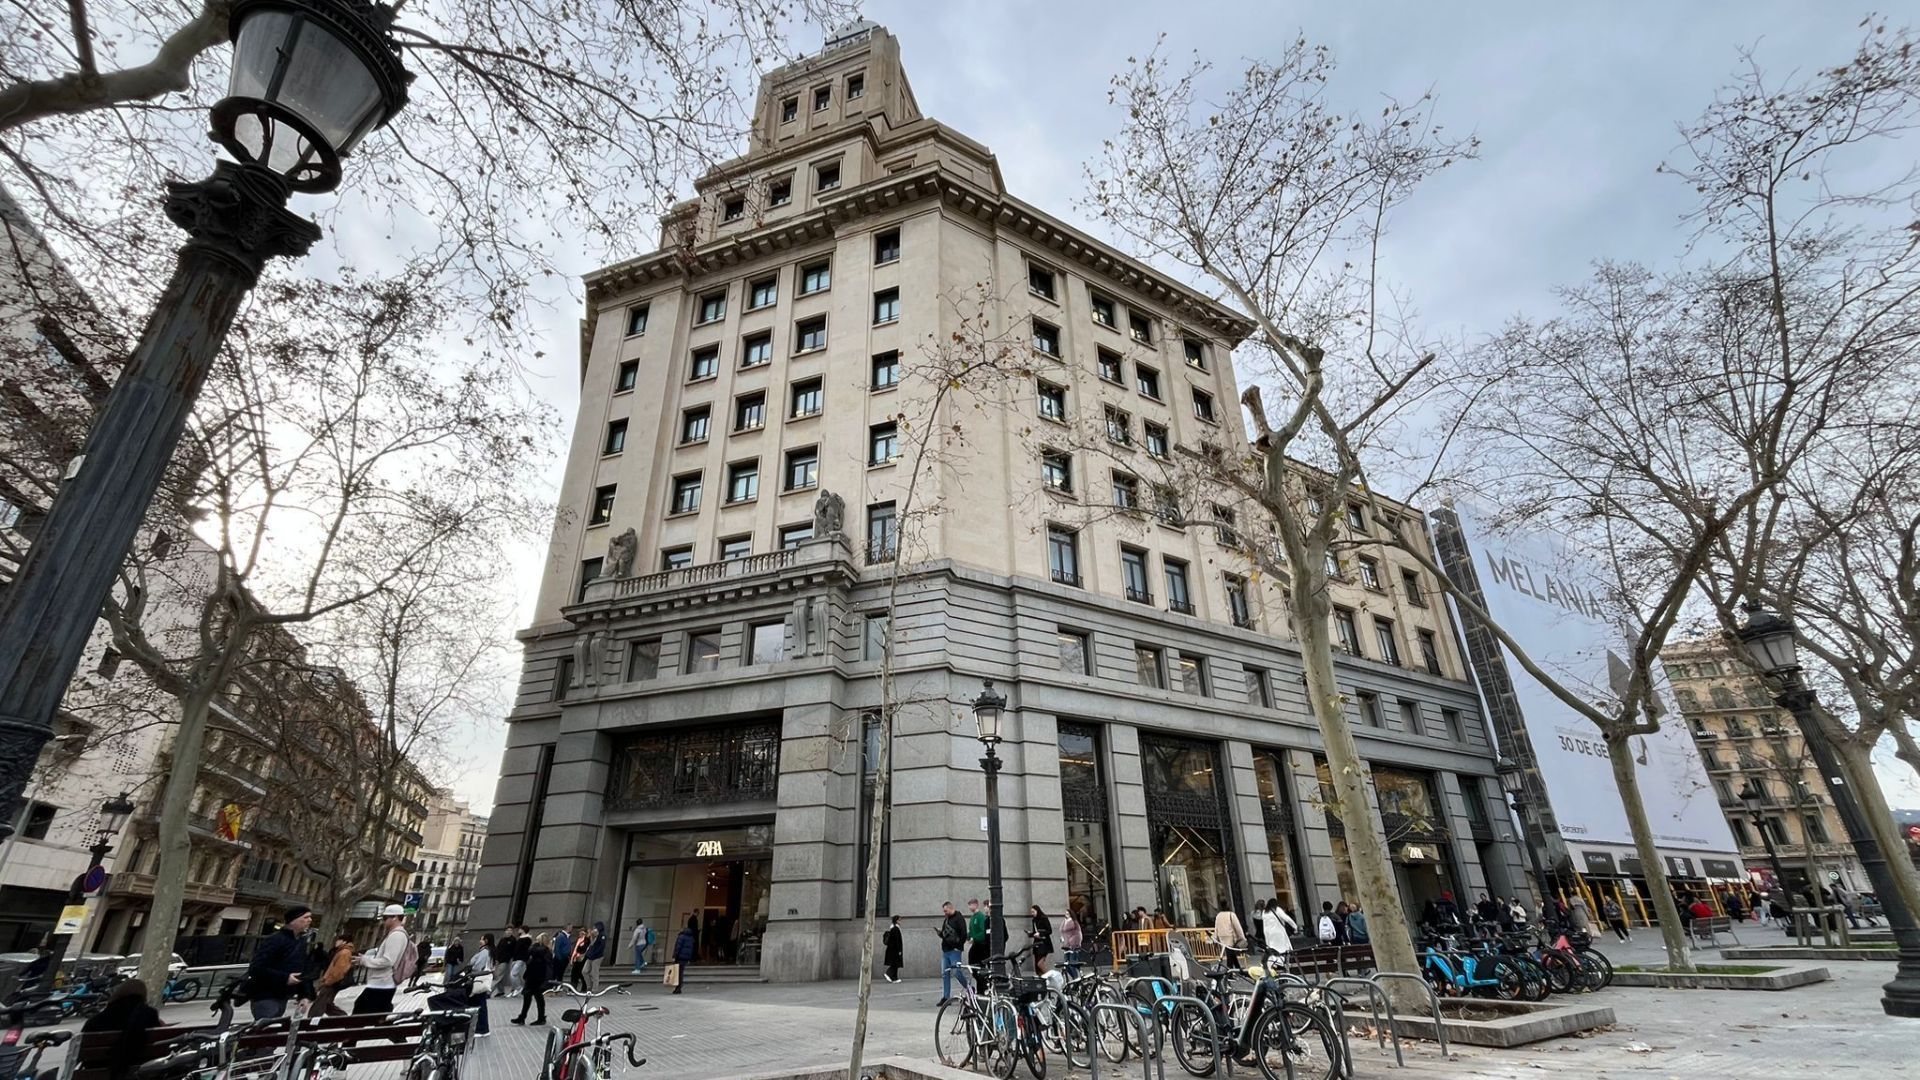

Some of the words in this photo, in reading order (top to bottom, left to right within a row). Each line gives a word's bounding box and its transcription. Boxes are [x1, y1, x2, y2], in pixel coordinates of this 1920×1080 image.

[1485, 549, 1609, 623] MELANIA
[1558, 735, 1574, 752] 30
[1575, 739, 1592, 756] DE
[1593, 743, 1610, 760] GE
[696, 840, 724, 857] ZARA
[403, 894, 413, 906] P
